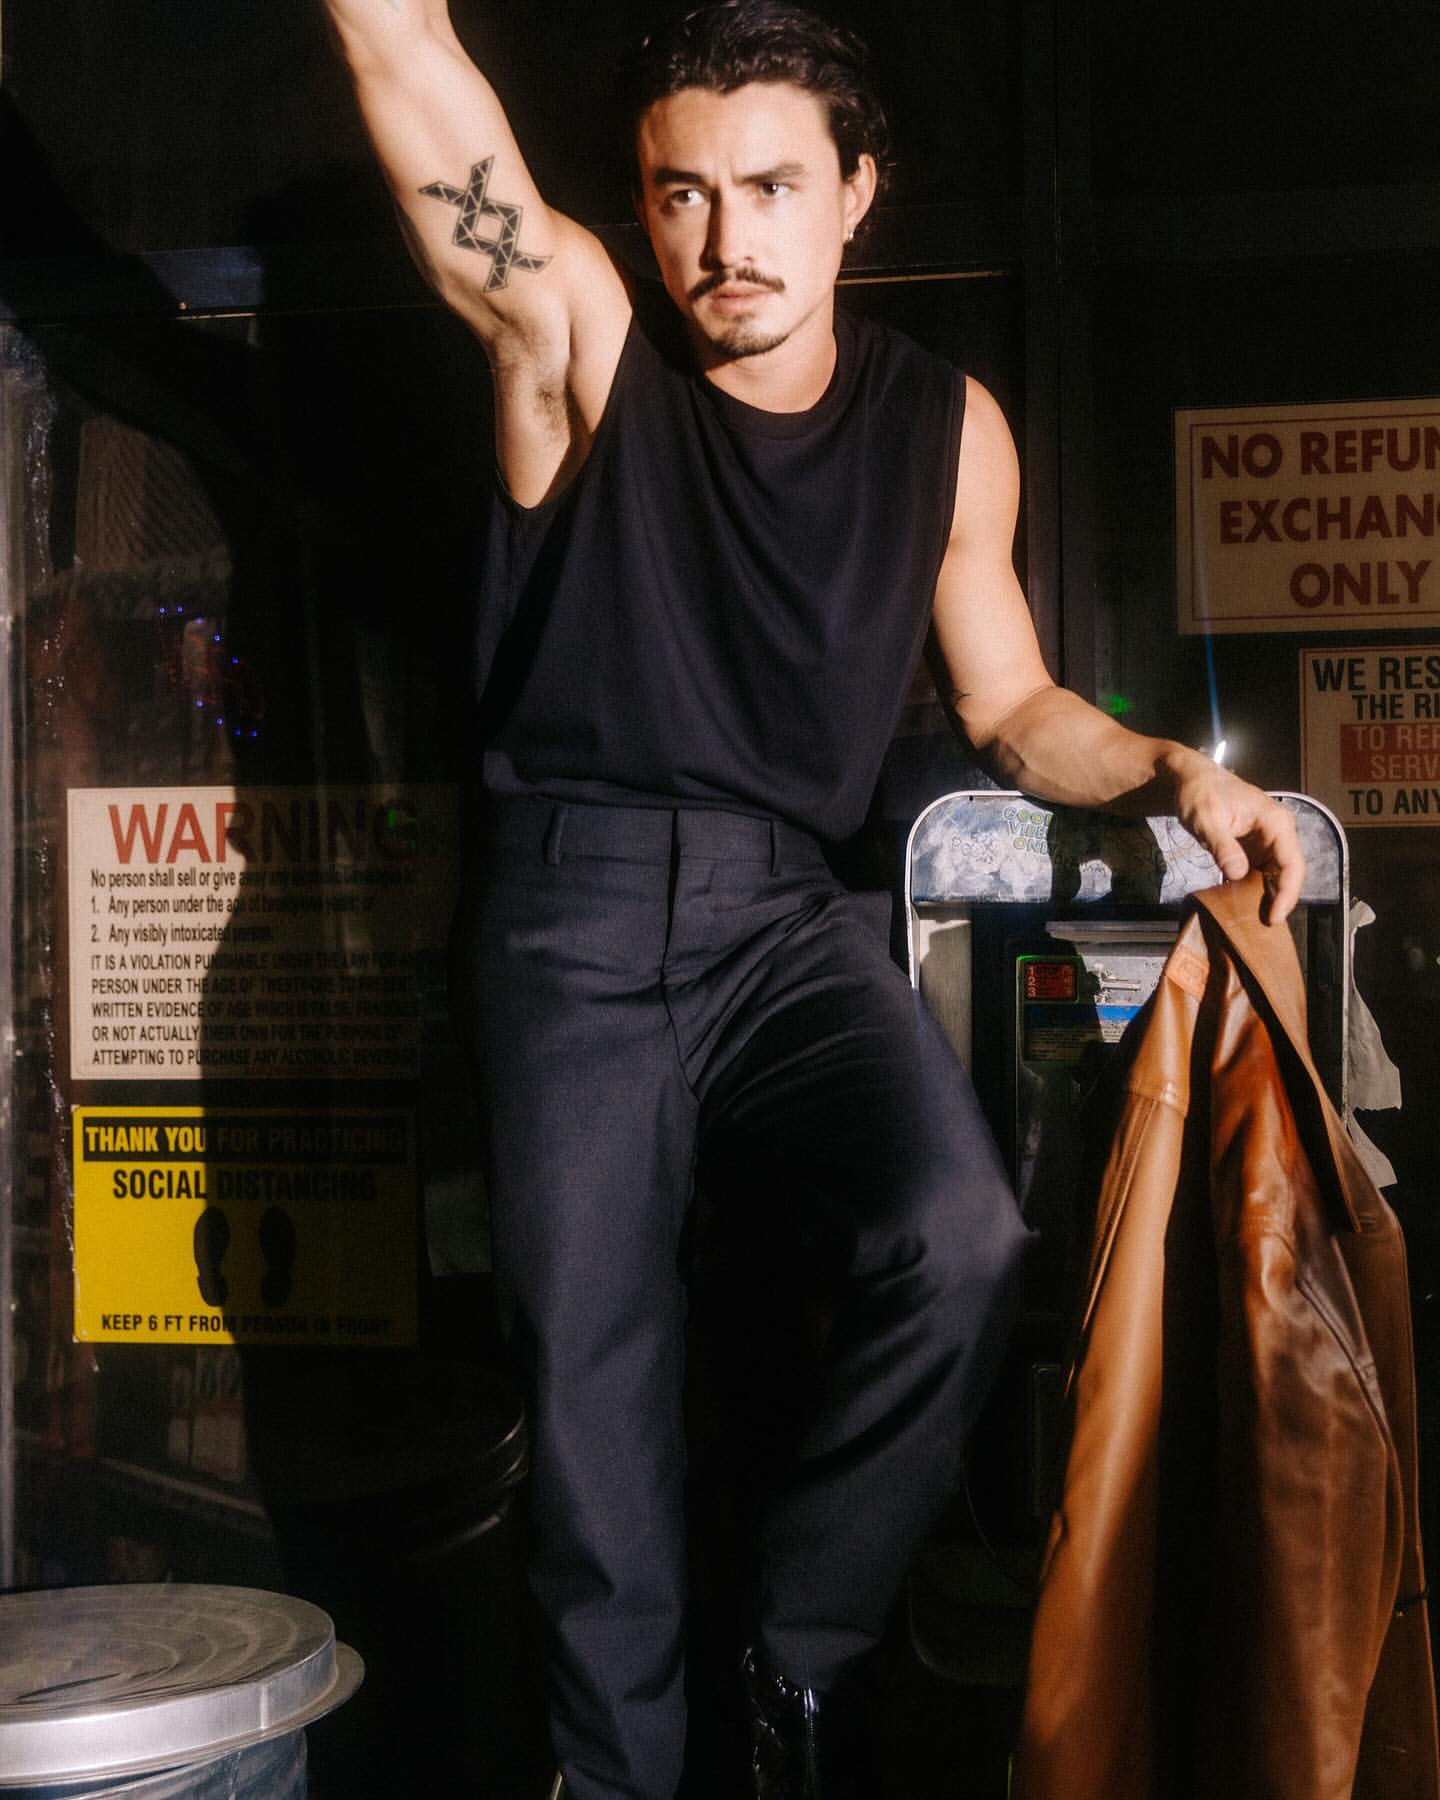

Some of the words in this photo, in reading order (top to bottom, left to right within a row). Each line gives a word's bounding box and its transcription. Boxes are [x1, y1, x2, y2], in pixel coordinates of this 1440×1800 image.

[1202, 433, 1282, 479] NO
[1220, 494, 1440, 544] EXCHAN
[1289, 560, 1431, 608] ONLY
[1312, 657, 1366, 692] WE
[1379, 656, 1440, 690] RES
[1351, 693, 1404, 720] THE
[1352, 726, 1385, 751] TO
[1369, 754, 1440, 779] SERV
[1348, 789, 1383, 815] TO
[108, 800, 417, 864] WARNING
[91, 869, 106, 888] No
[109, 872, 146, 891] person
[149, 868, 175, 886] shall
[178, 868, 197, 886] sell
[199, 872, 210, 886] or
[213, 869, 236, 891] give
[91, 897, 100, 913] 1.
[109, 896, 129, 916] Any
[132, 899, 170, 917] person
[173, 895, 205, 913] under
[206, 895, 224, 912] the
[91, 926, 100, 943] 2.
[109, 926, 129, 947] Any
[133, 925, 168, 946] visibly
[171, 925, 231, 943] intoxicated
[91, 954, 102, 970] IT
[105, 954, 116, 970] IS
[118, 954, 127, 970] A
[130, 954, 191, 970] VIOLATION
[91, 977, 138, 994] PERSON
[143, 977, 183, 994] UNDER
[187, 977, 209, 994] THE
[92, 1001, 143, 1017] WRITTEN
[146, 1001, 204, 1017] EVIDENCE
[91, 1025, 109, 1041] OR
[113, 1025, 136, 1041] NOT
[140, 1025, 199, 1041] ACTUALLY
[92, 1049, 165, 1065] ATTEMPTING
[169, 1049, 184, 1065] TO
[188, 1049, 250, 1065] PURCHASE
[85, 1126, 161, 1154] THANK
[163, 1126, 207, 1154] YOU
[217, 1126, 260, 1153] FOR
[270, 1126, 404, 1153] PRACTICING
[113, 1169, 208, 1200] SOCIAL
[216, 1170, 379, 1200] DISTANCING
[102, 1314, 141, 1331] KEEP
[148, 1314, 157, 1331] 6
[164, 1314, 183, 1332] FT
[189, 1315, 238, 1333] FROM
